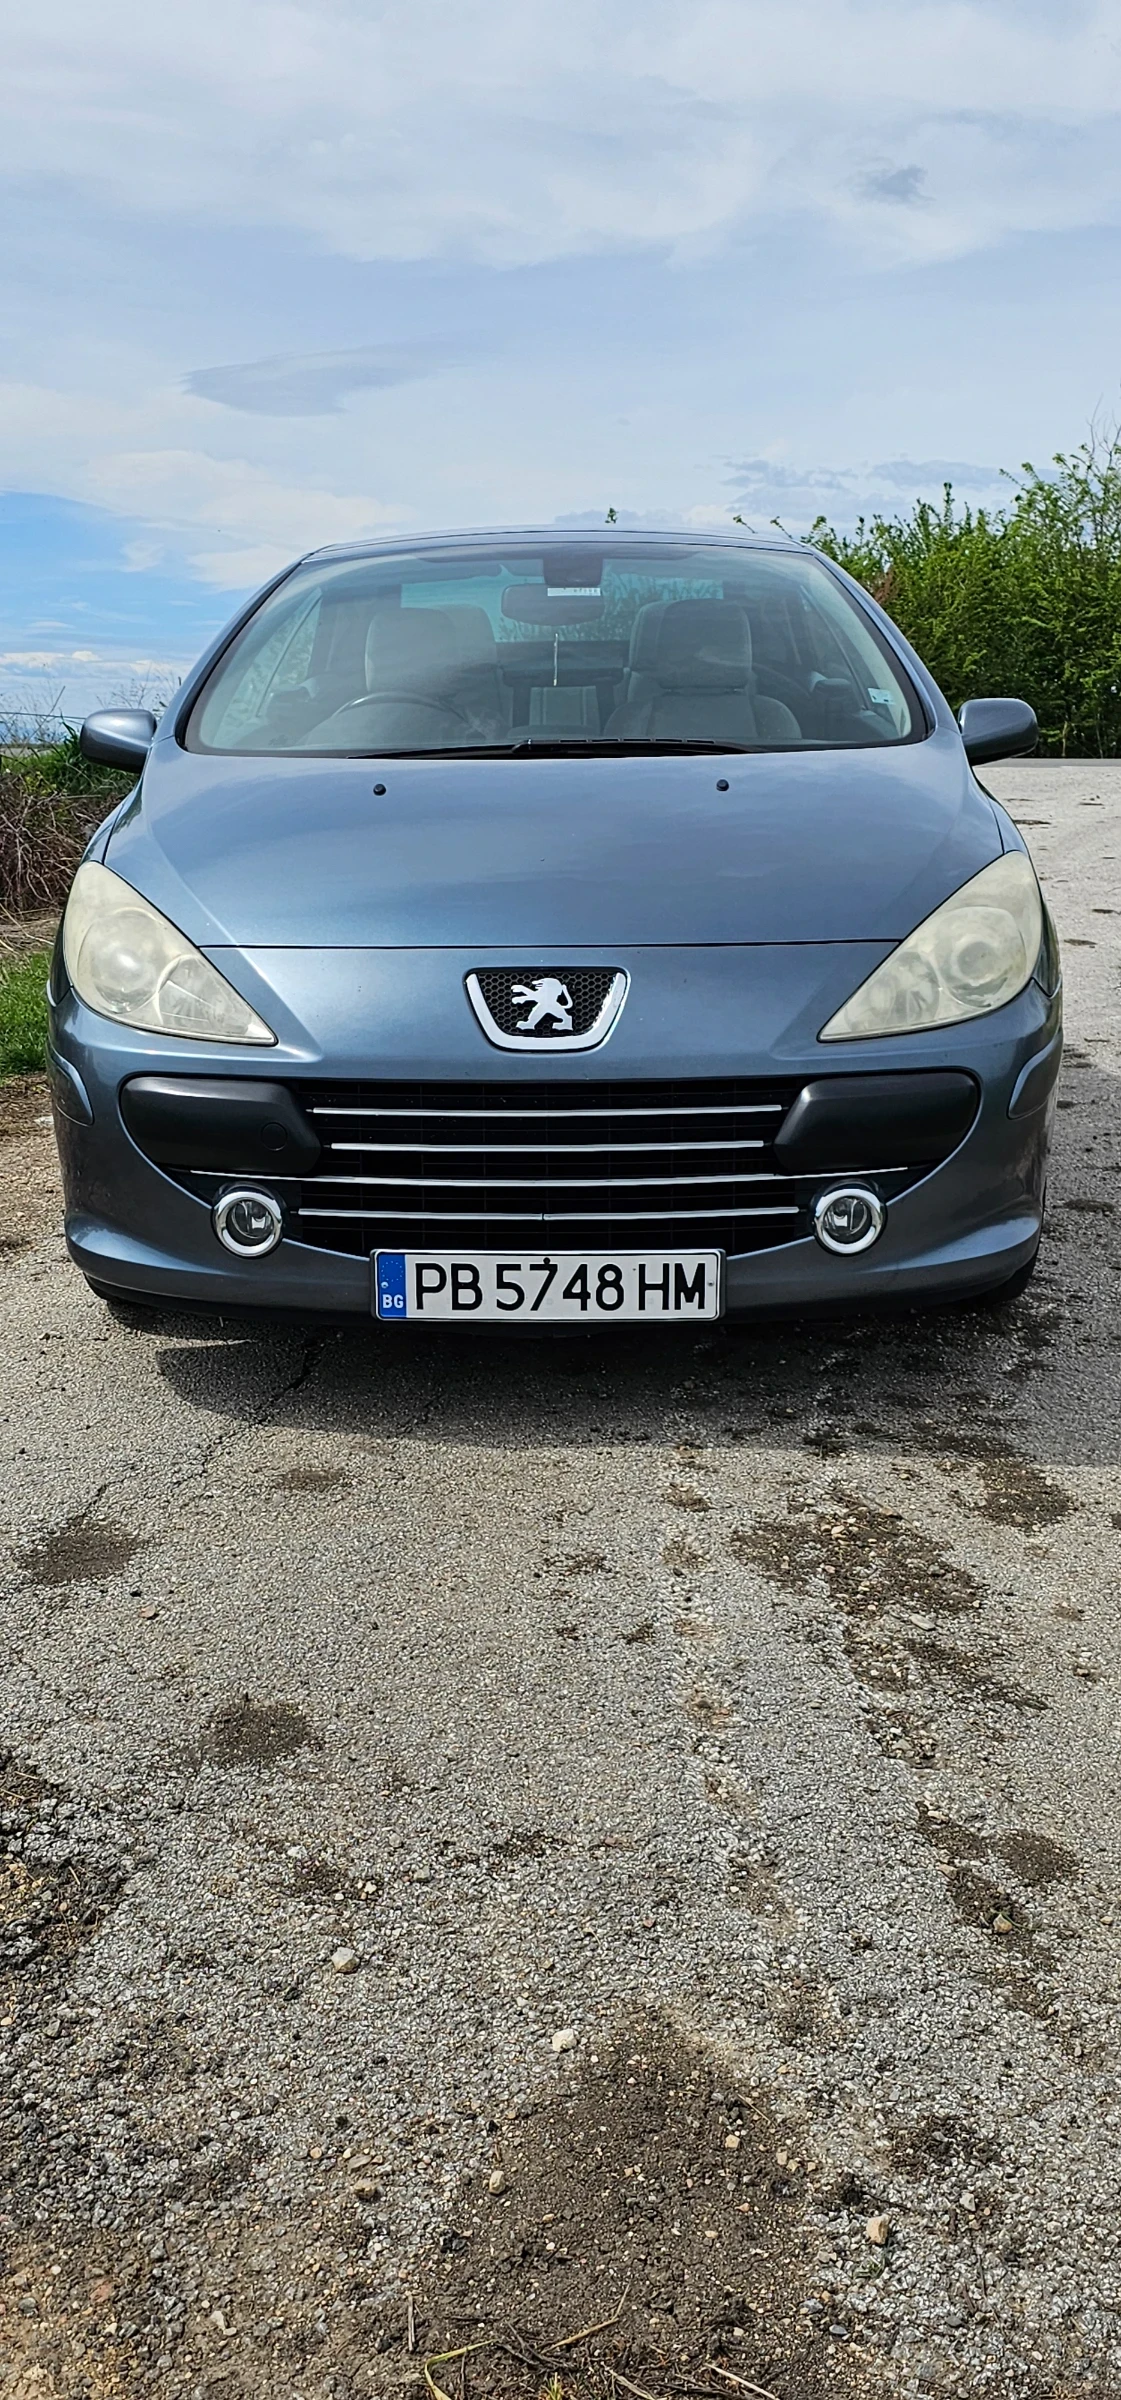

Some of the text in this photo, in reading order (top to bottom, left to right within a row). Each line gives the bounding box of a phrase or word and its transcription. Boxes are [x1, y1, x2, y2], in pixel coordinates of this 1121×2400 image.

[382, 1294, 404, 1309] BG
[415, 1262, 706, 1312] PB 5748 HM
